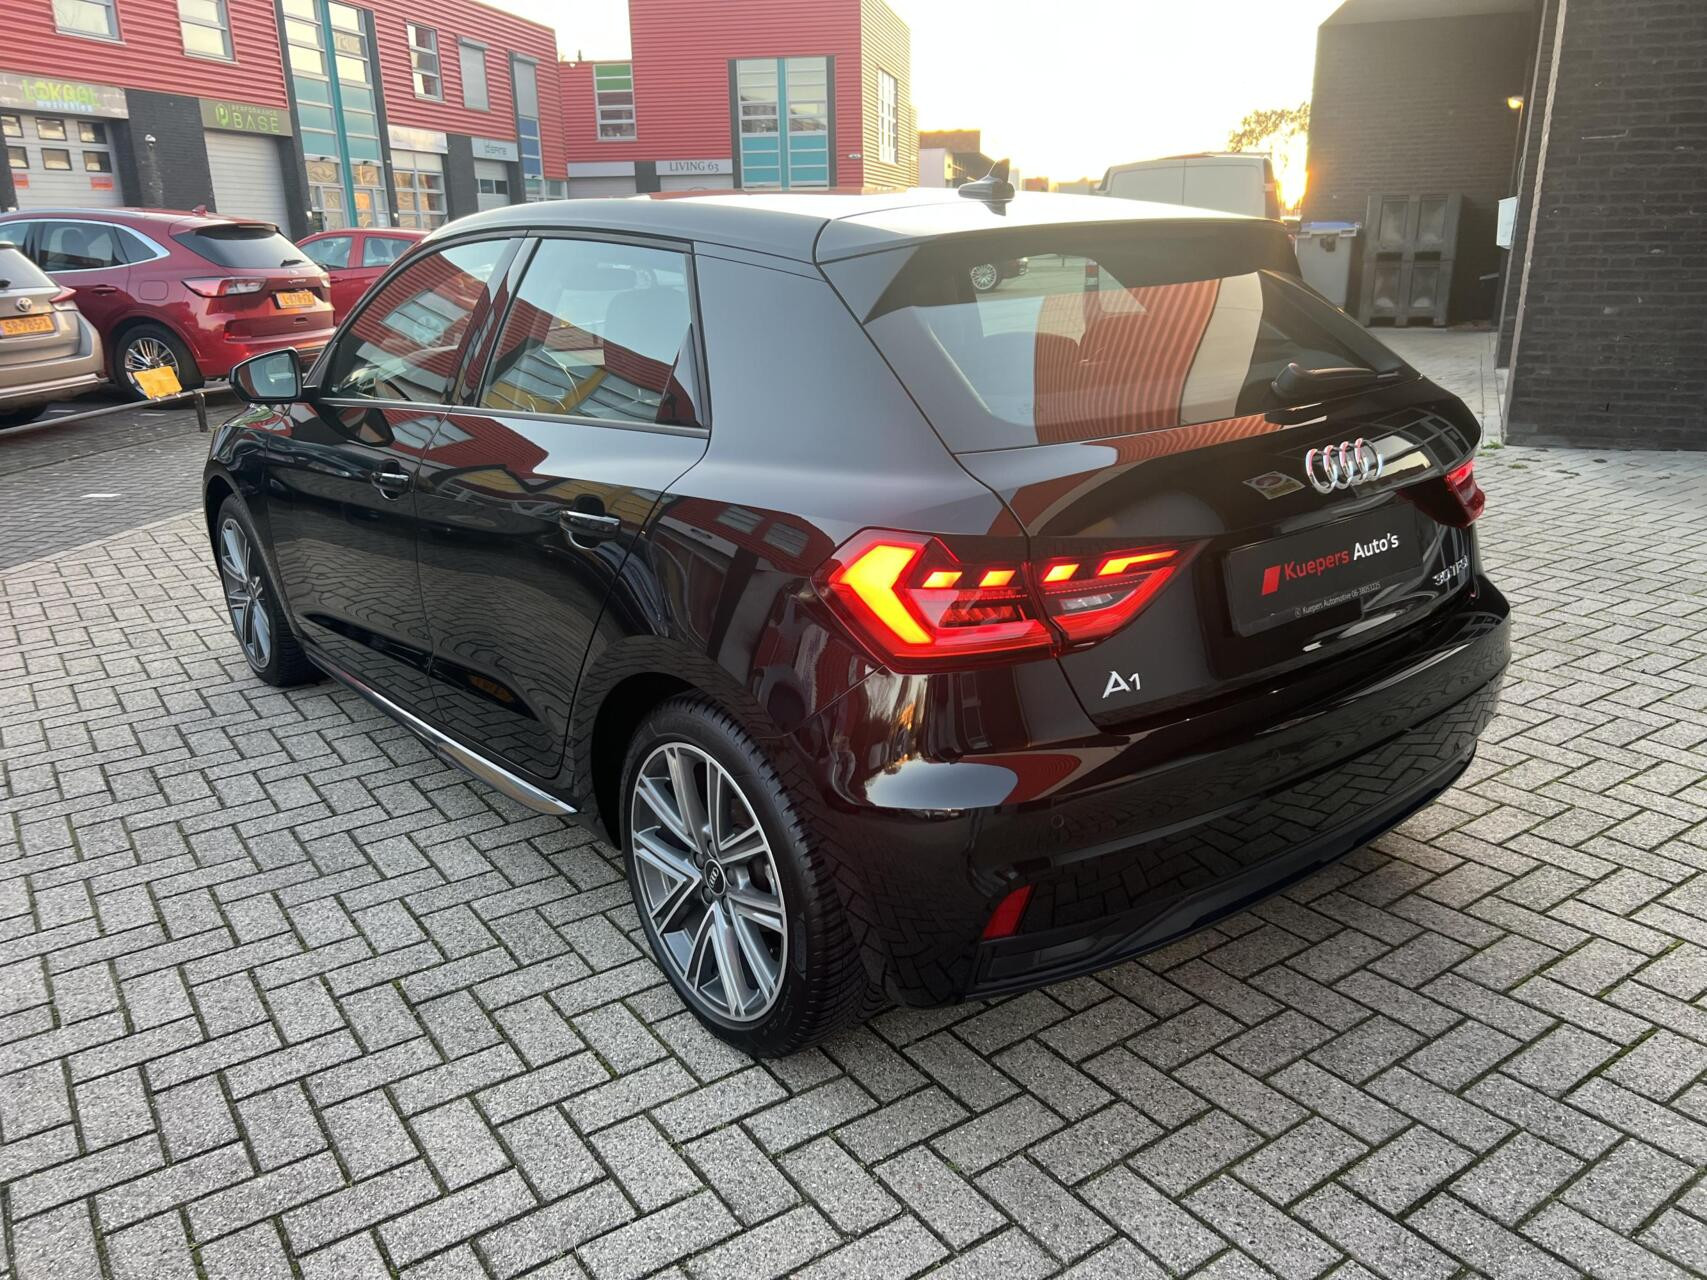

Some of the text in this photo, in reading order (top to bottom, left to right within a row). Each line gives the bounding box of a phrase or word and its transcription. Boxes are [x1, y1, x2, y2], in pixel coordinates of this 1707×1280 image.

[233, 112, 279, 133] BASE
[670, 161, 720, 173] LIVING 63
[1284, 532, 1399, 580] Kuepers Auto's
[1302, 602, 1323, 615] Kuepers
[1323, 593, 1352, 608] Automotive
[1101, 670, 1141, 699] A1
